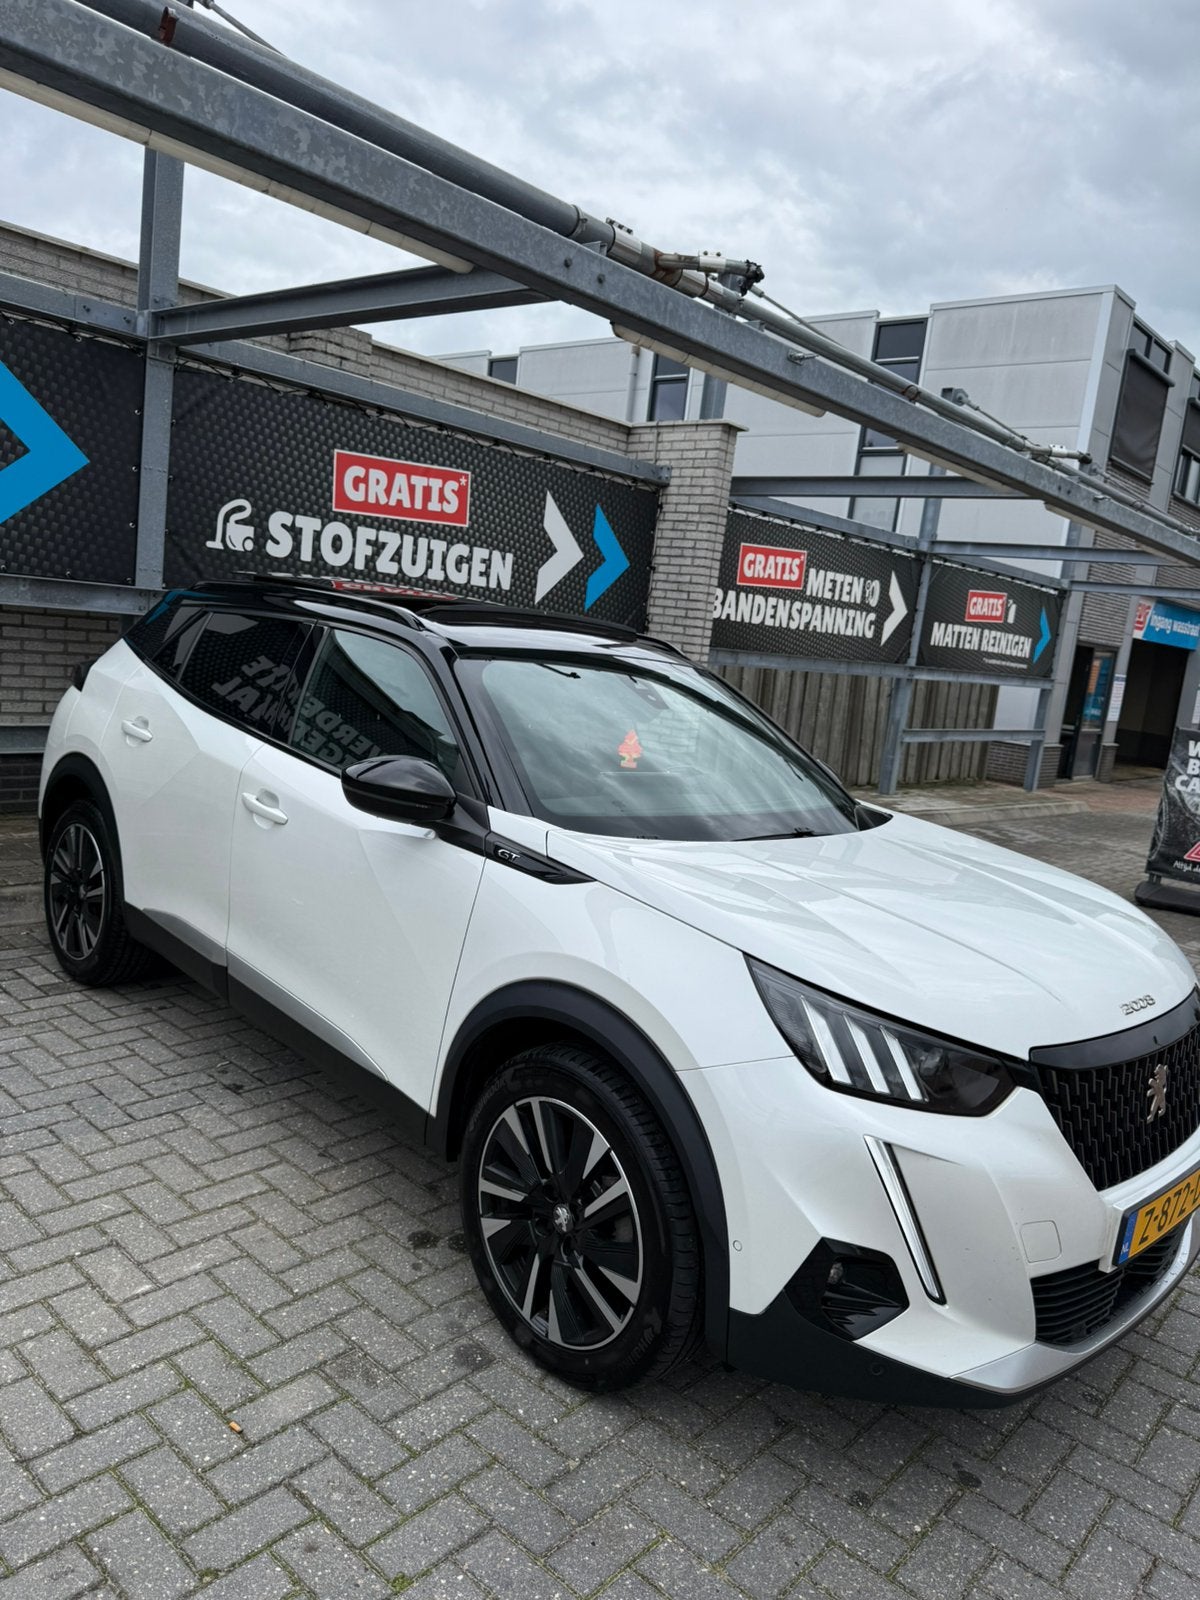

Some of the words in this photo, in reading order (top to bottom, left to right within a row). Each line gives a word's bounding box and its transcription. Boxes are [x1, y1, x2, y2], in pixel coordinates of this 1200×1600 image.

[265, 511, 513, 590] STOFZUIGEN
[806, 568, 864, 604] METEN
[712, 588, 876, 638] BANDENSPANNING
[930, 622, 982, 651] MATTEN
[981, 629, 1033, 658] REINIGEN
[1175, 774, 1200, 793] CA
[1187, 758, 1200, 775] B
[498, 848, 521, 862] GT
[1120, 994, 1156, 1016] 2008
[1138, 1173, 1200, 1246] Z-872-
